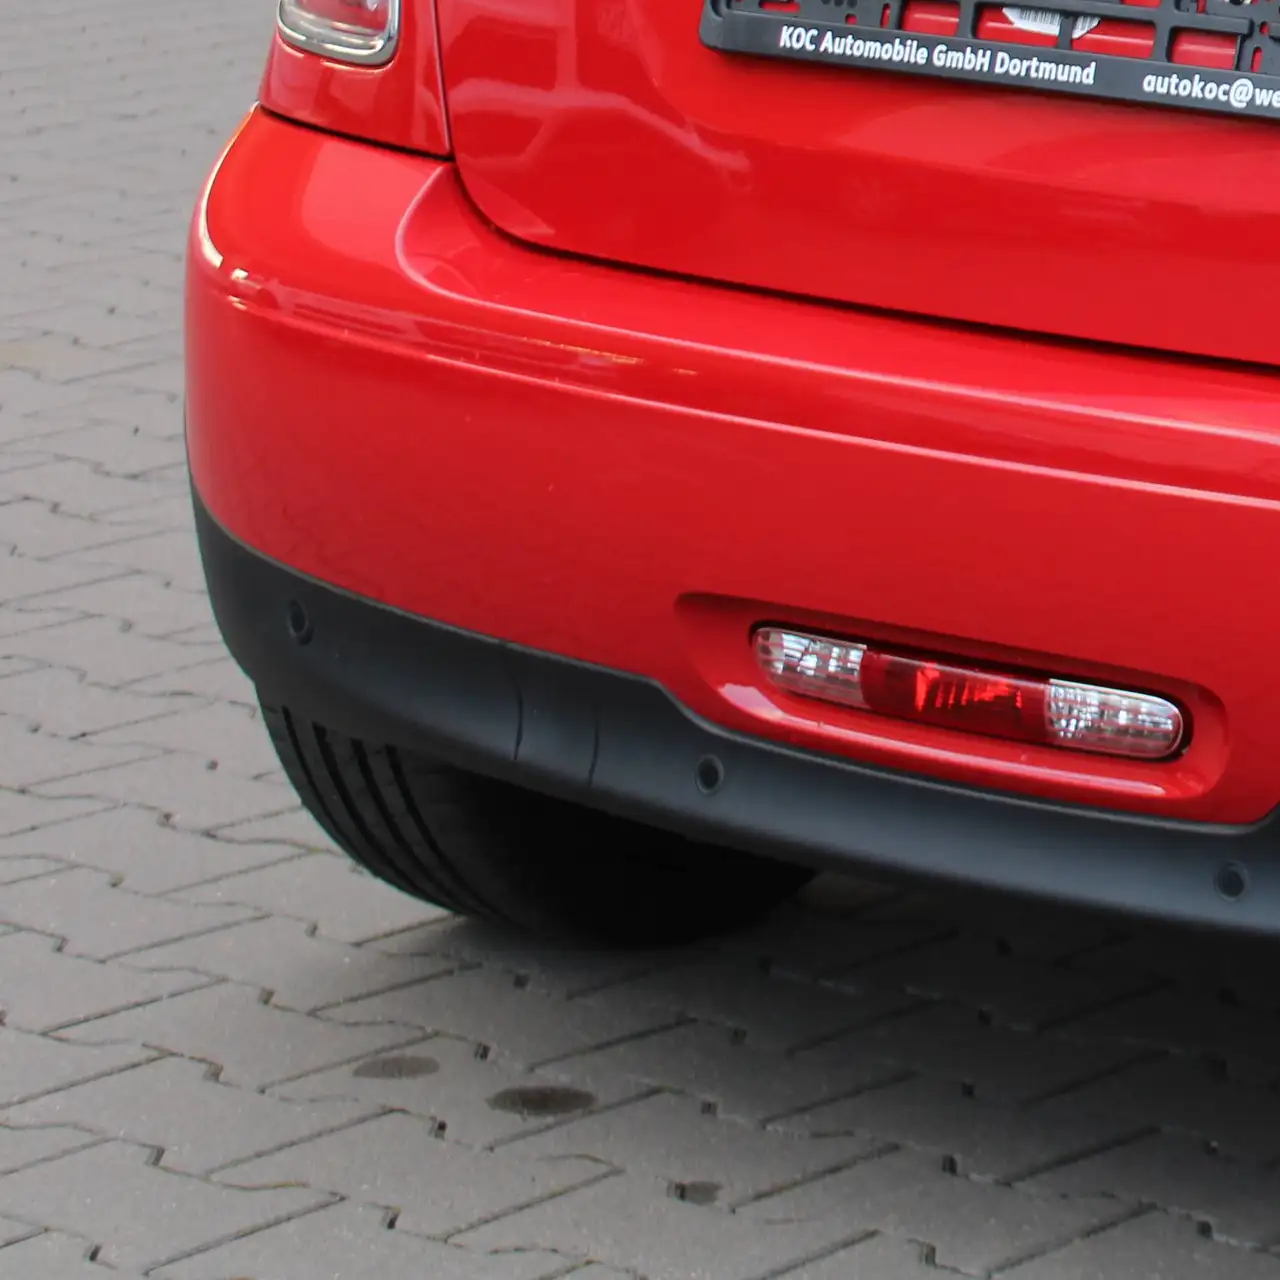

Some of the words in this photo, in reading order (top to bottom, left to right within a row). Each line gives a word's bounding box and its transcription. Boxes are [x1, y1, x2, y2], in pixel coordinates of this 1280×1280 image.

[779, 25, 818, 50] KOC
[820, 30, 928, 64] Automobile
[932, 45, 991, 71] GmbH
[995, 51, 1096, 85] Dortmund
